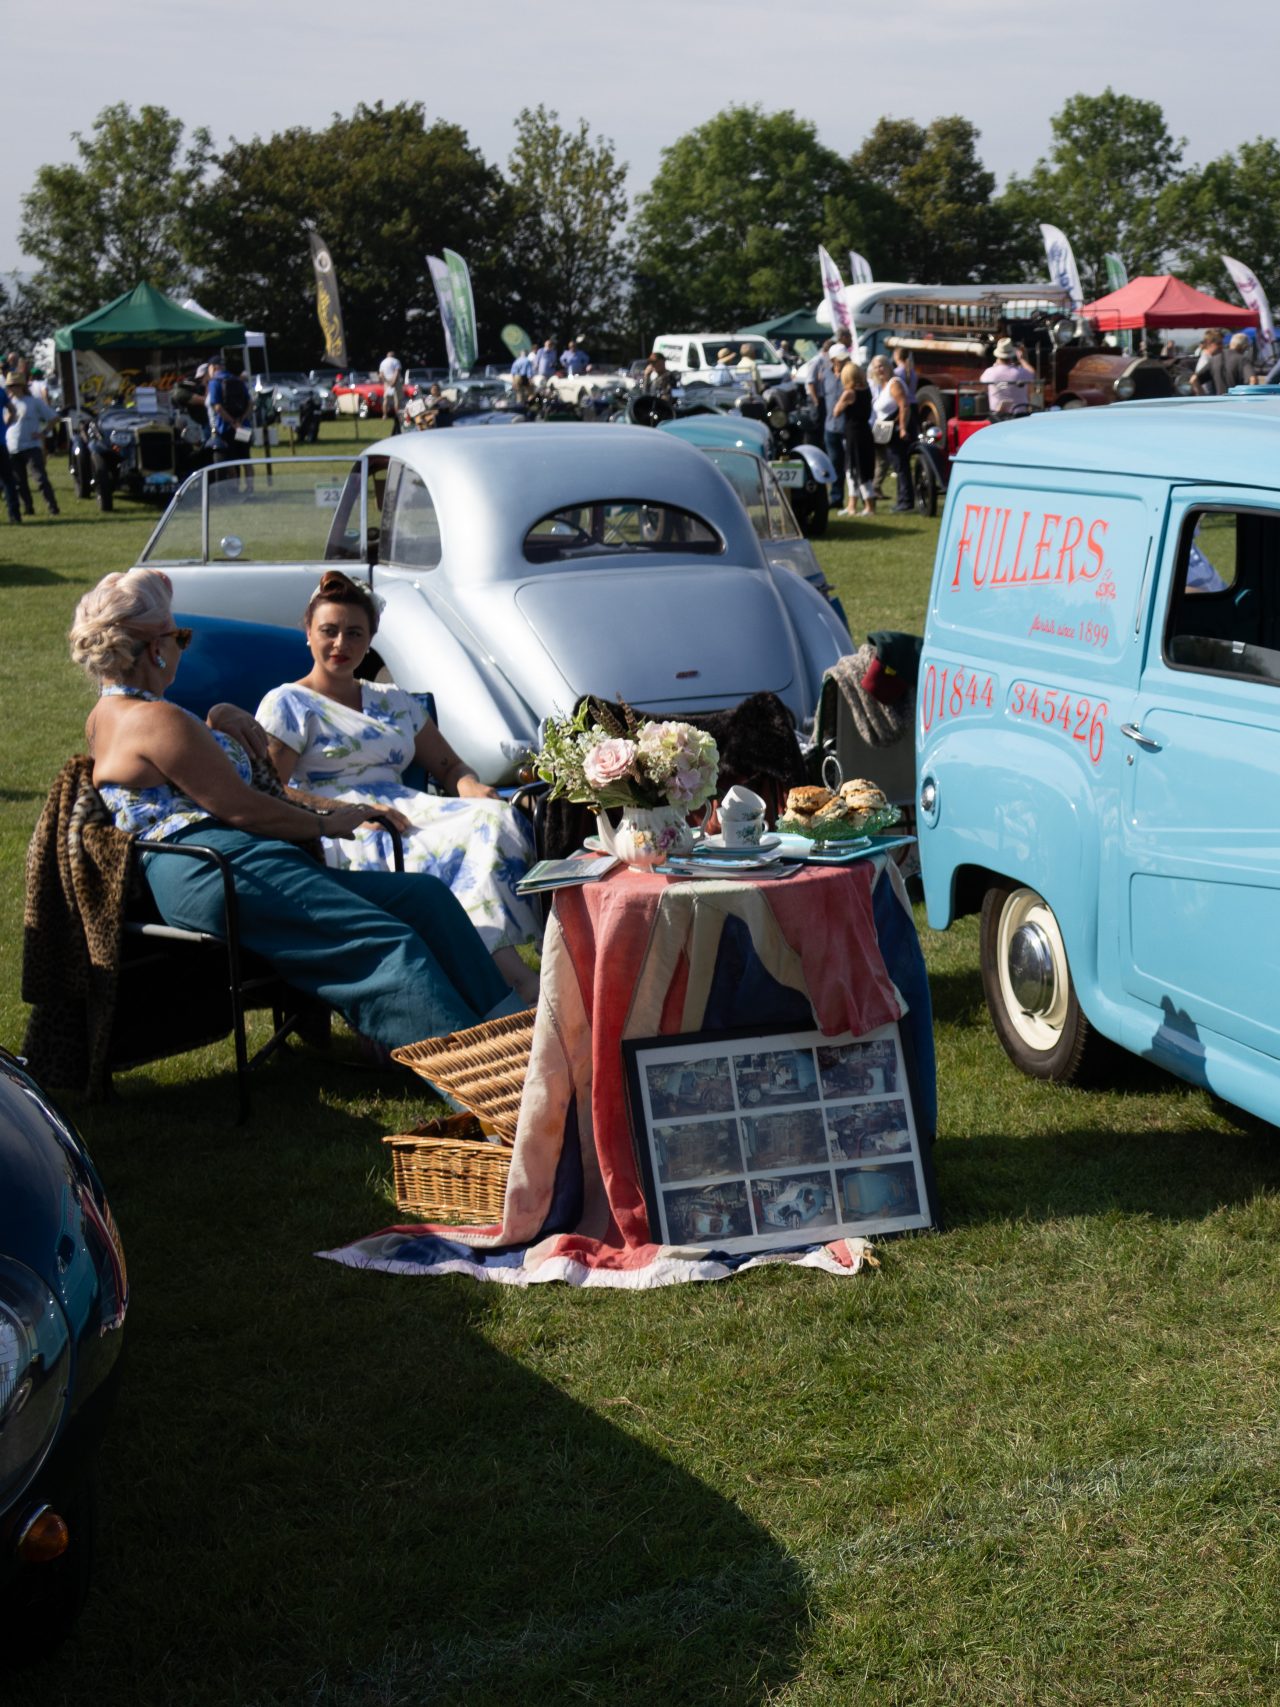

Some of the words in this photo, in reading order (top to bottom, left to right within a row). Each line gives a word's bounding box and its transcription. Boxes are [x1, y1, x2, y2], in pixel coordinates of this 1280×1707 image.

[951, 504, 1109, 591] FULLERS
[1079, 618, 1109, 648] 1899
[923, 664, 995, 734] 01844
[1010, 683, 1109, 766] 345426
